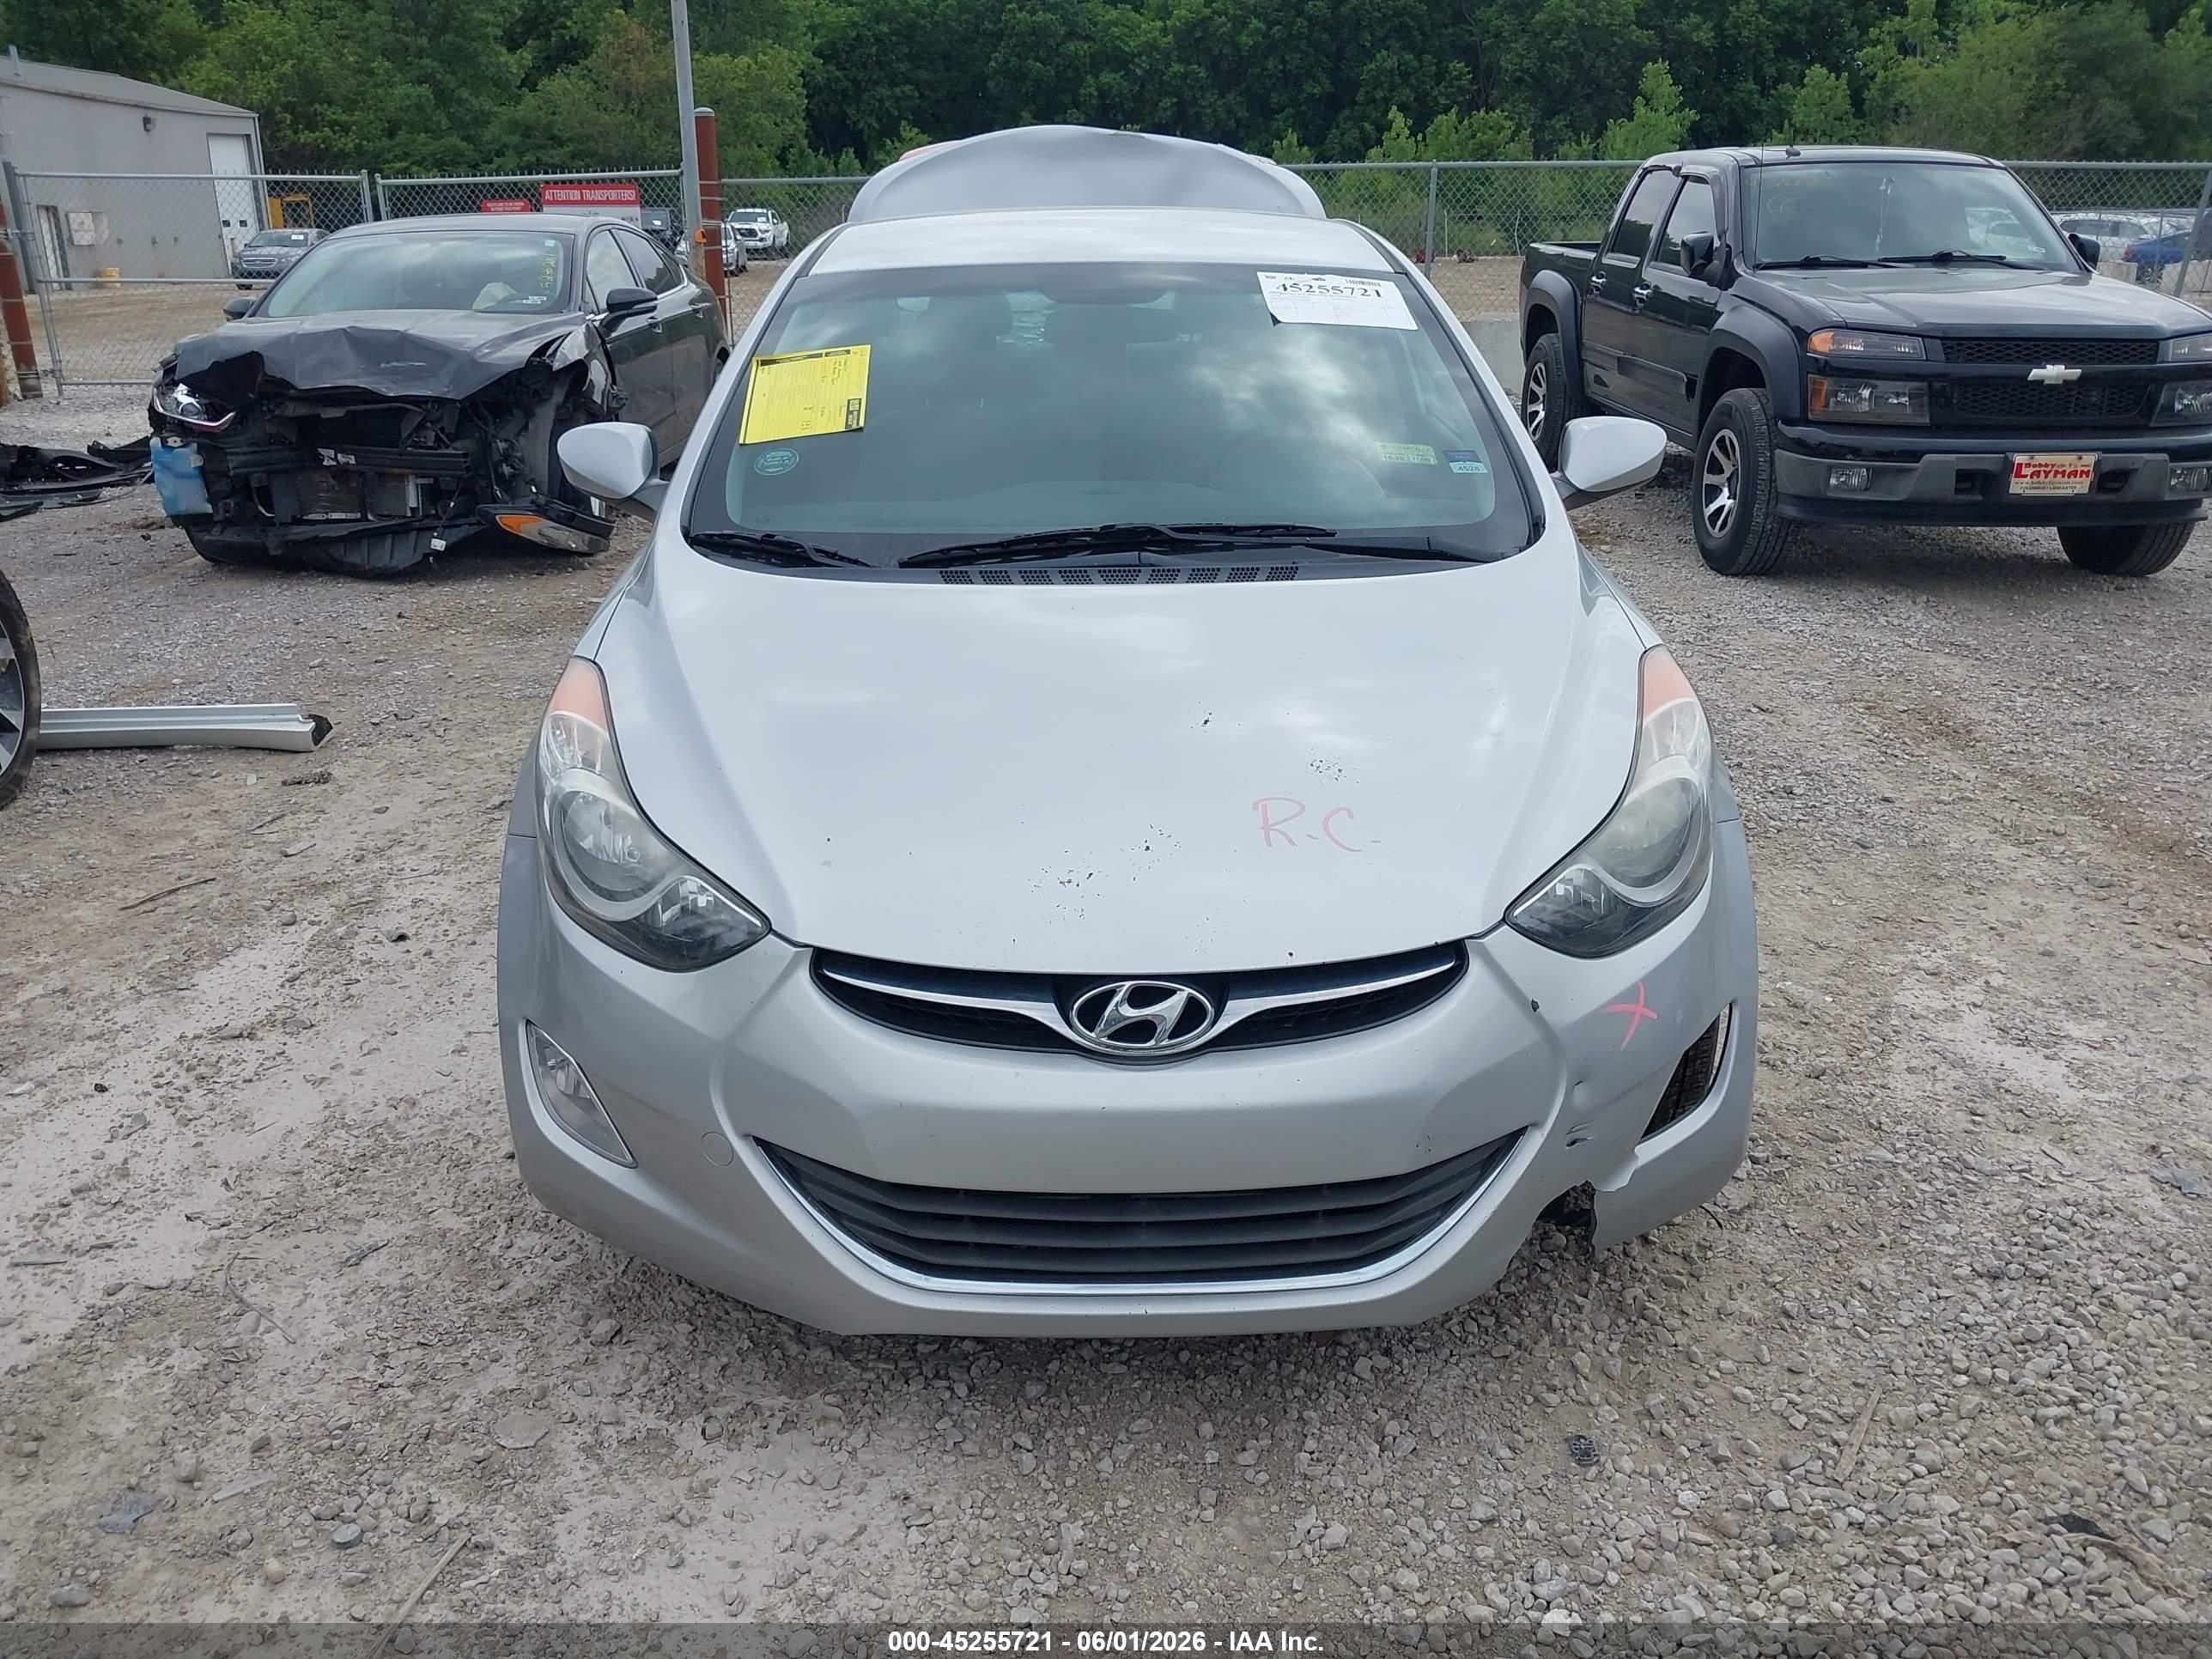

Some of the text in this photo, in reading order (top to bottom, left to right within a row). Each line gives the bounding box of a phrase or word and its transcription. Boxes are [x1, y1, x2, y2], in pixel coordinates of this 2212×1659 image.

[544, 189, 636, 201] ATTENTION TRANSPORTERS!
[2013, 462, 2092, 479] LAYMAN
